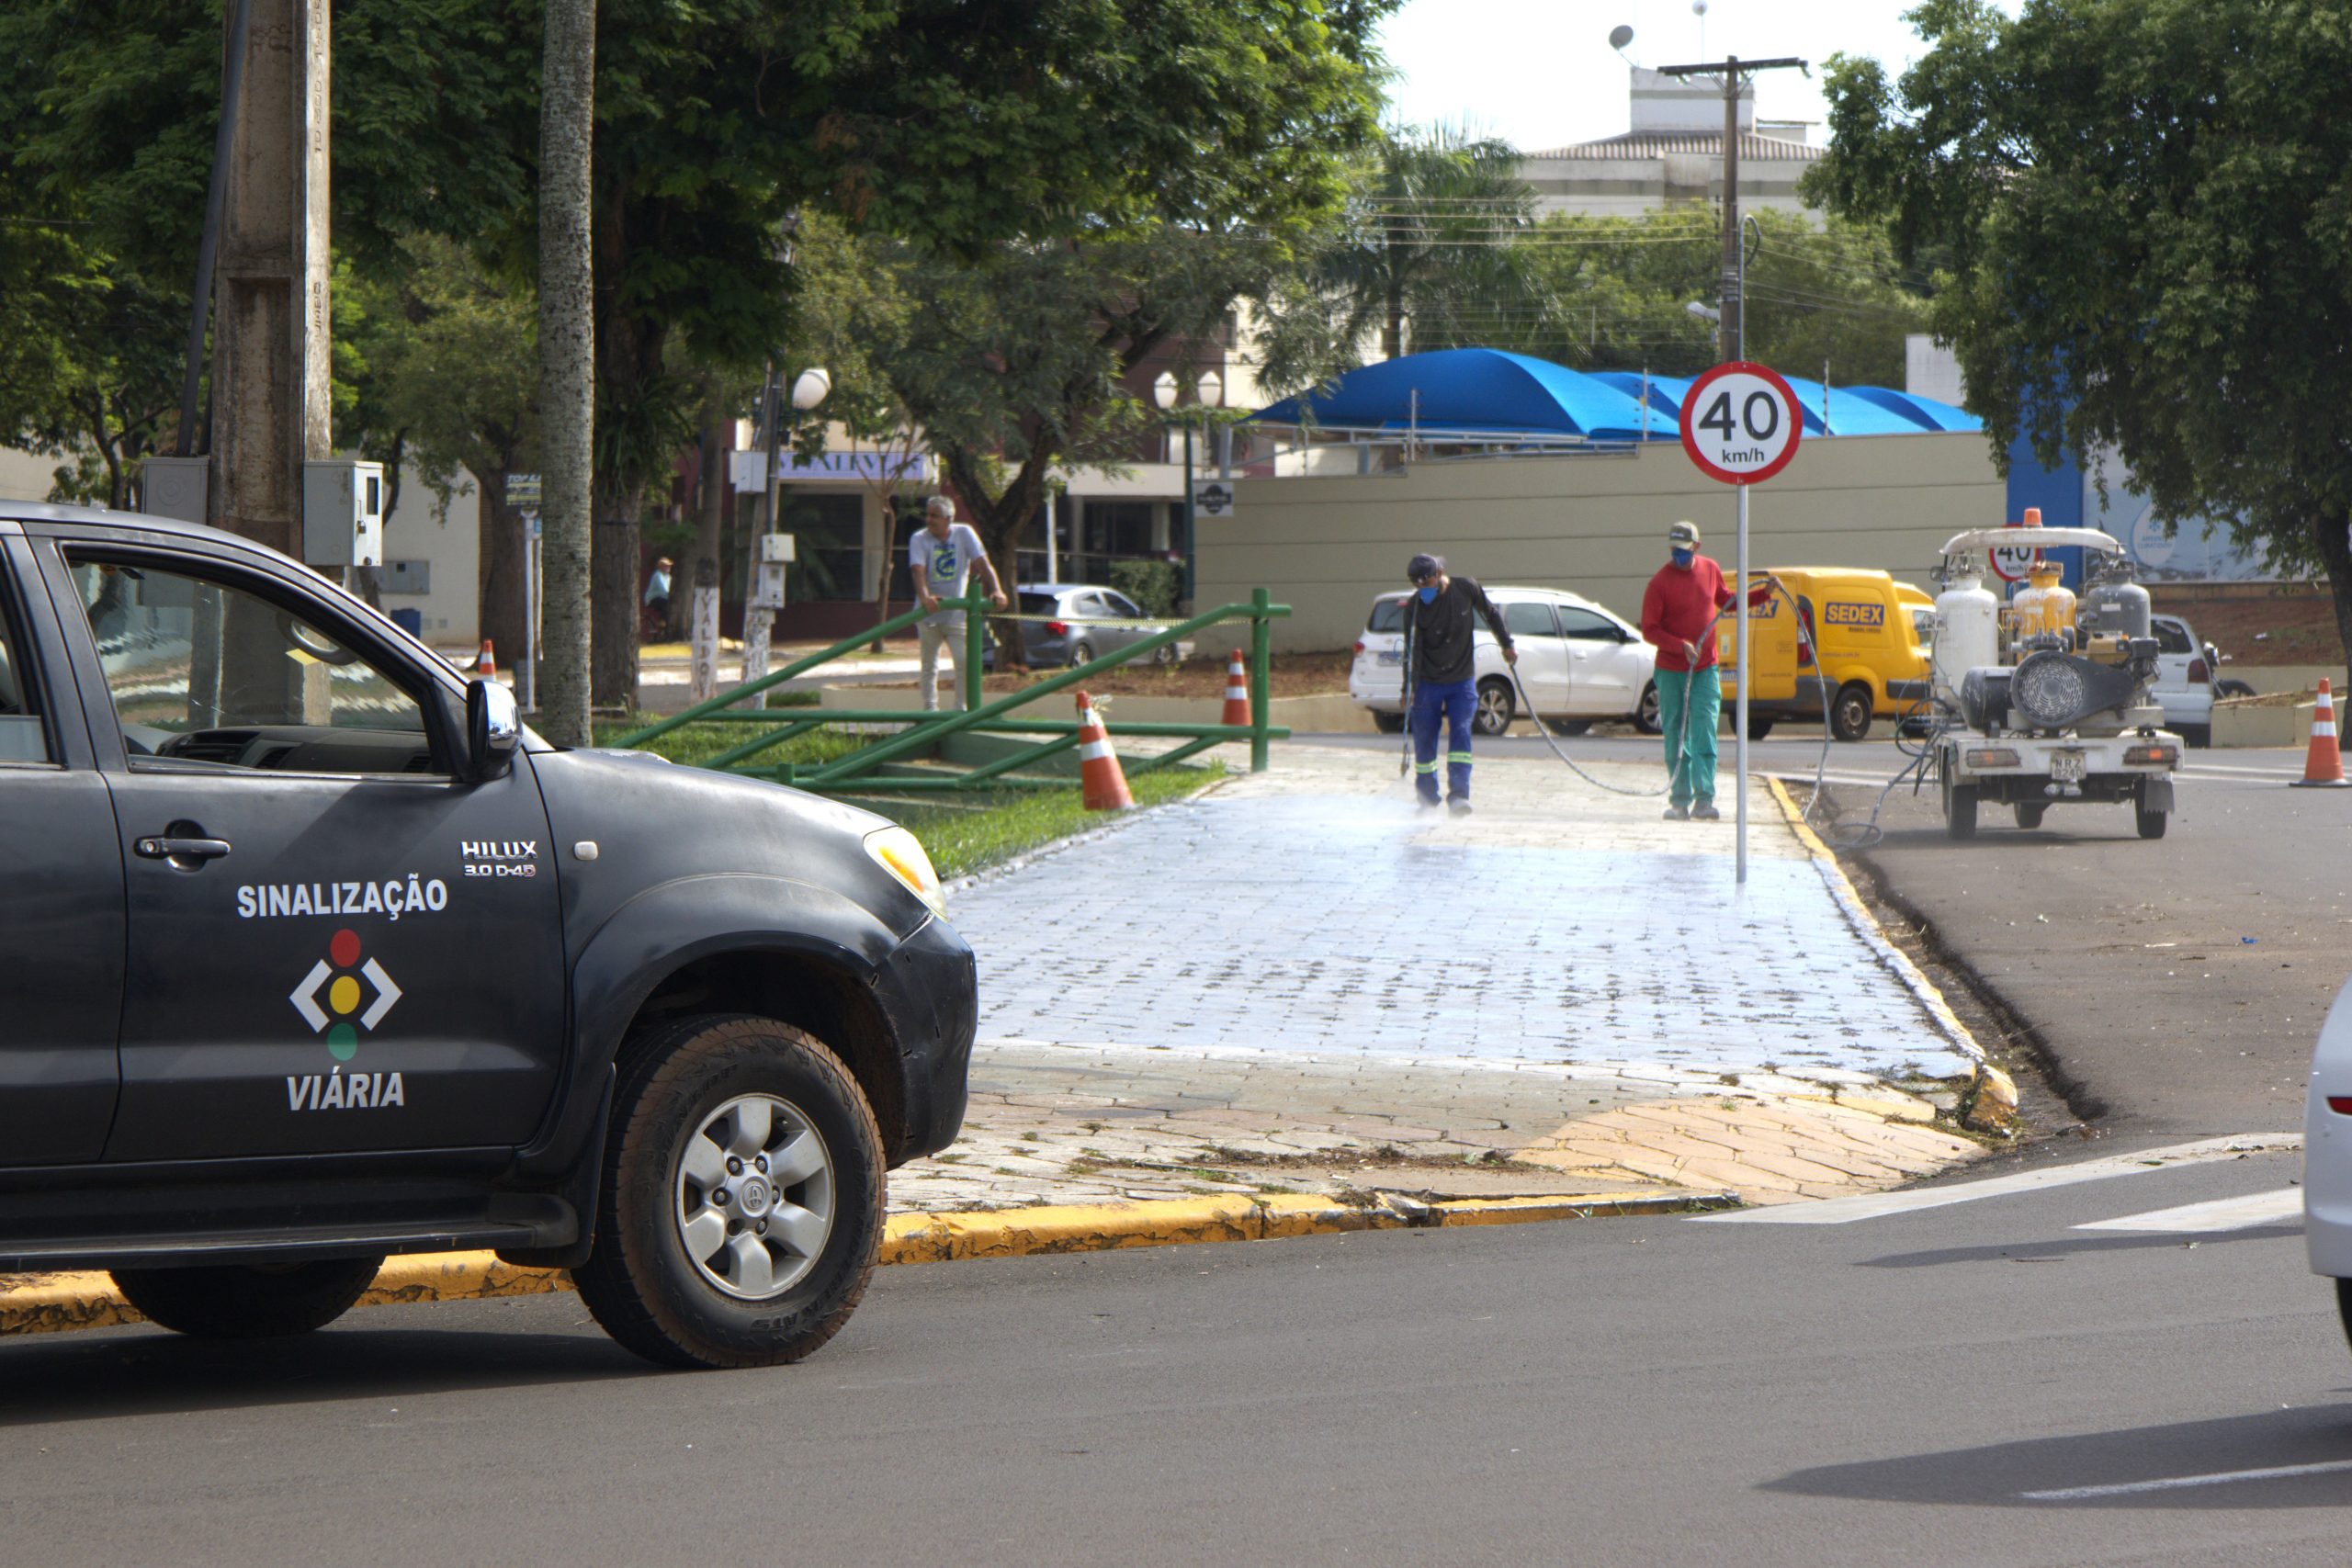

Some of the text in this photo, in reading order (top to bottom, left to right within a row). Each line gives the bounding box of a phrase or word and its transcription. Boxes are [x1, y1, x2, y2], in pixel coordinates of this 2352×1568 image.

[1698, 390, 1779, 441] 40
[1721, 447, 1765, 463] km/h
[1996, 546, 2030, 562] 40
[1826, 604, 1883, 624] SEDEX
[461, 840, 538, 860] HILUX
[236, 874, 448, 920] SINALIZAÇÃO
[286, 1066, 405, 1111] VIÁRIA
